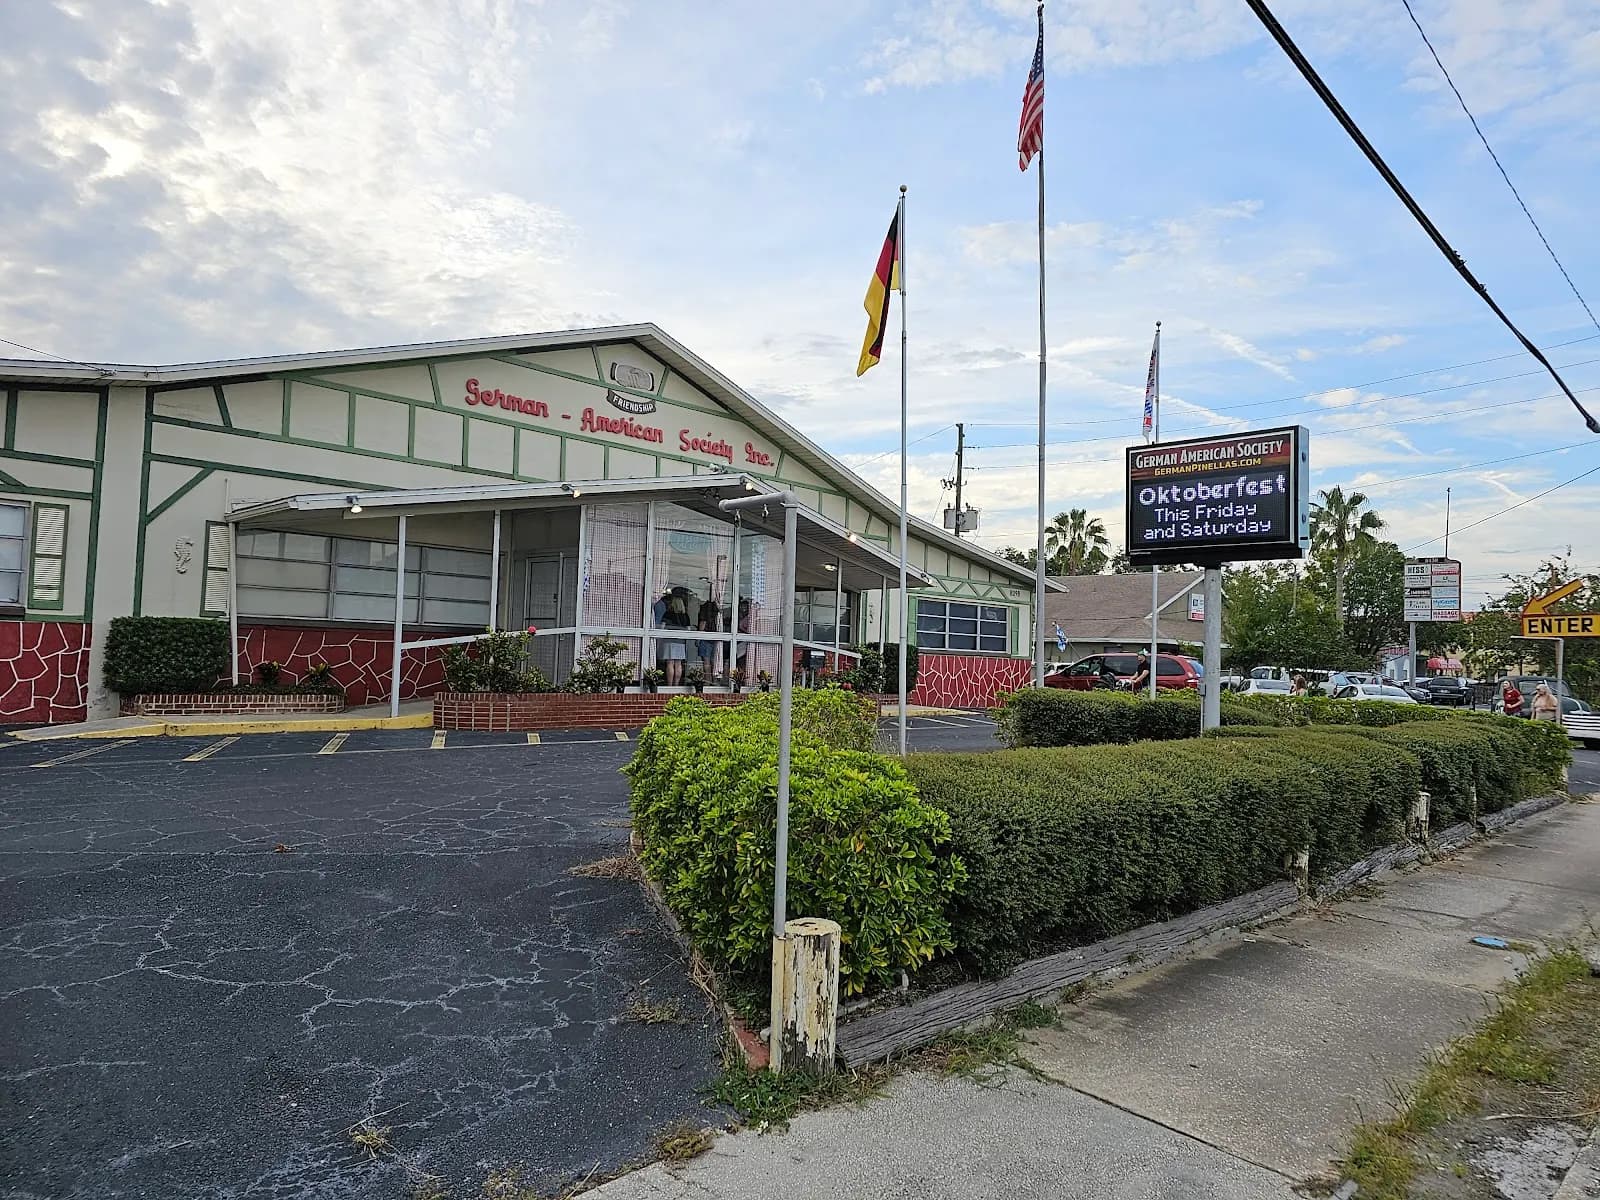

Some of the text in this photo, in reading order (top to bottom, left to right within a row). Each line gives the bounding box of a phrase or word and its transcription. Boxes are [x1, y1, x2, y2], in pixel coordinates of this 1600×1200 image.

[612, 395, 655, 412] FRIENDSHIP
[581, 407, 663, 443] American
[679, 429, 733, 464] Society
[744, 441, 775, 468] Inc.
[1135, 440, 1283, 469] GERMAN AMERICAN SOCIETY
[1154, 458, 1261, 476] GERMANPINELLAS.COM
[1139, 474, 1286, 506] Oktoberfest
[1154, 503, 1257, 523] This Friday
[1143, 519, 1271, 540] and Saturday
[1528, 618, 1593, 633] ENTER
